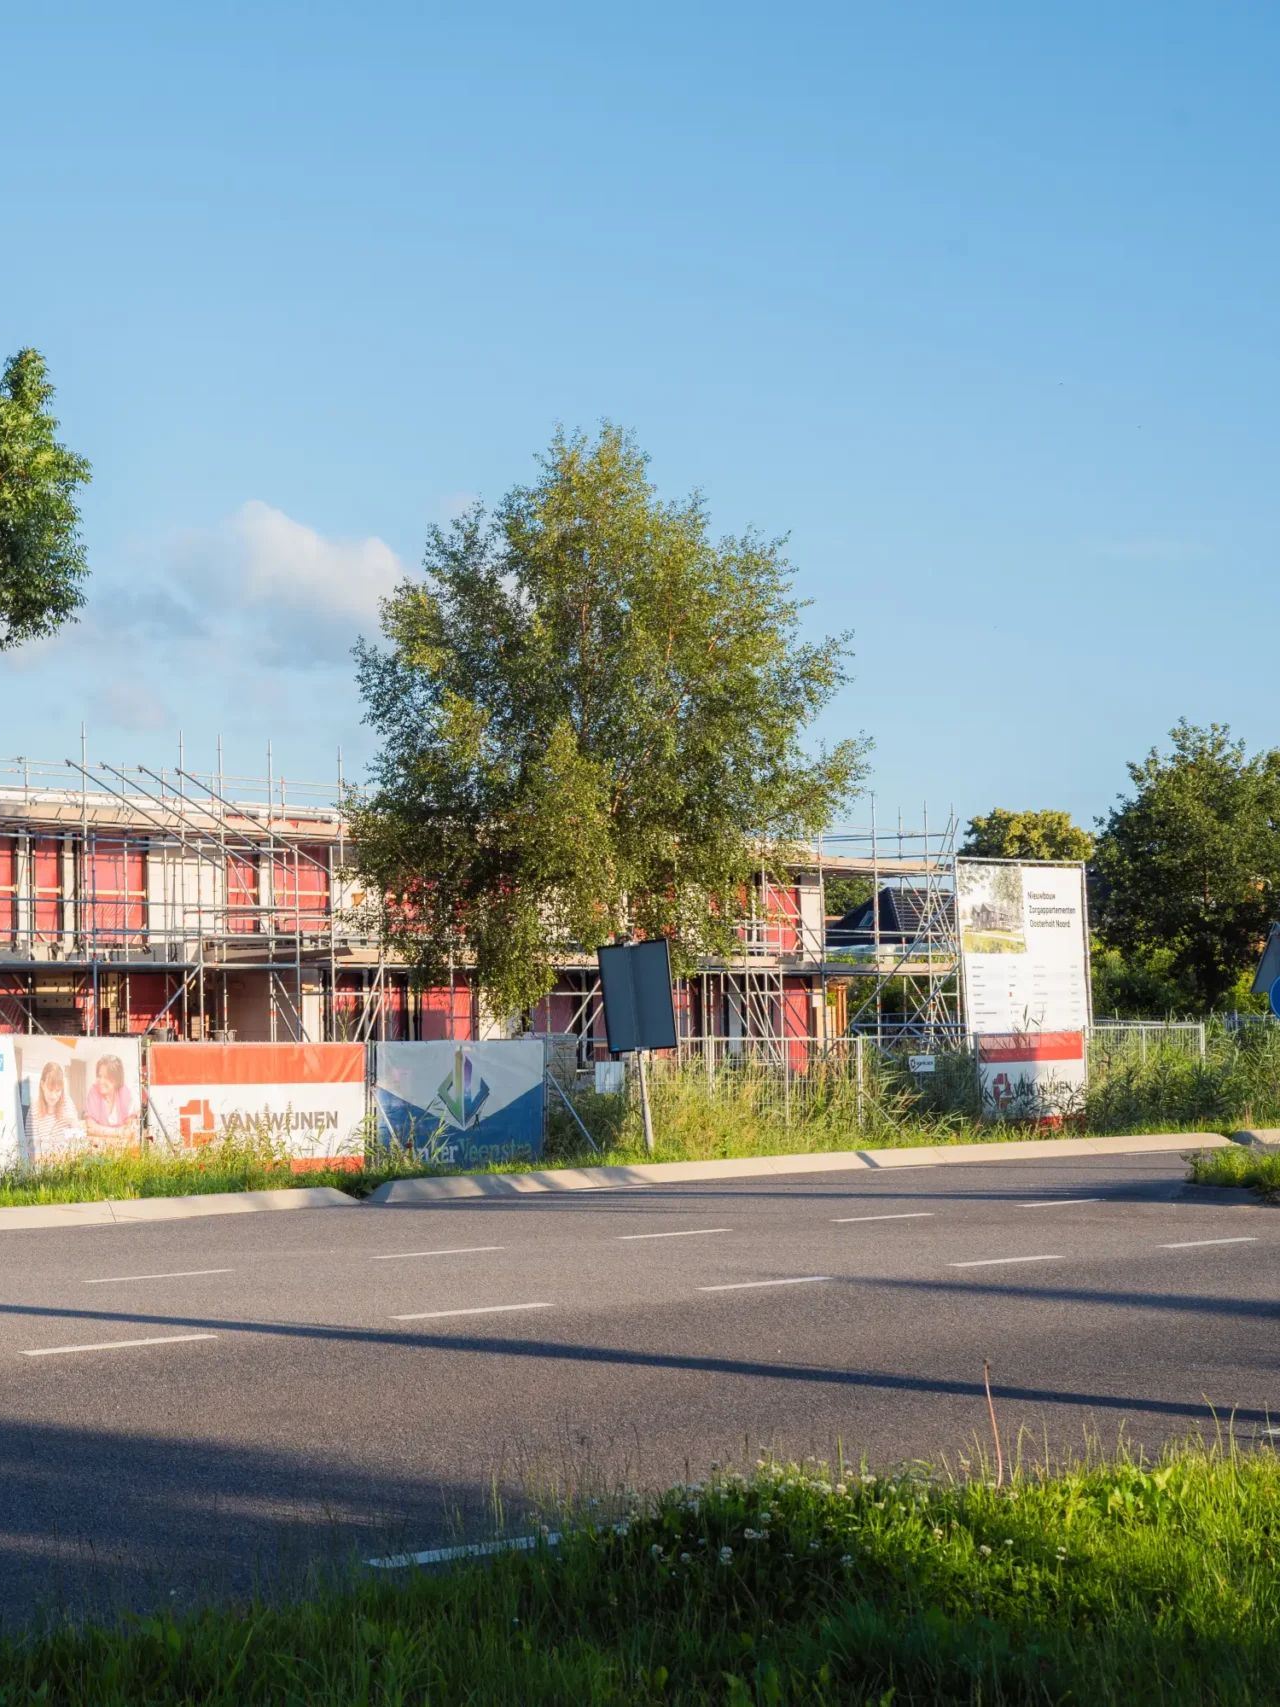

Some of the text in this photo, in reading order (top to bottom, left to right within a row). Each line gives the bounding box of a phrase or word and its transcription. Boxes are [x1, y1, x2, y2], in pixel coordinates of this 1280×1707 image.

[1027, 891, 1056, 900] Nieuwbouw
[1028, 905, 1076, 915] Zorgappartementen
[1030, 919, 1071, 928] Oosterholt Noord
[220, 1112, 260, 1131] VAN
[458, 1138, 532, 1165] Veenstra
